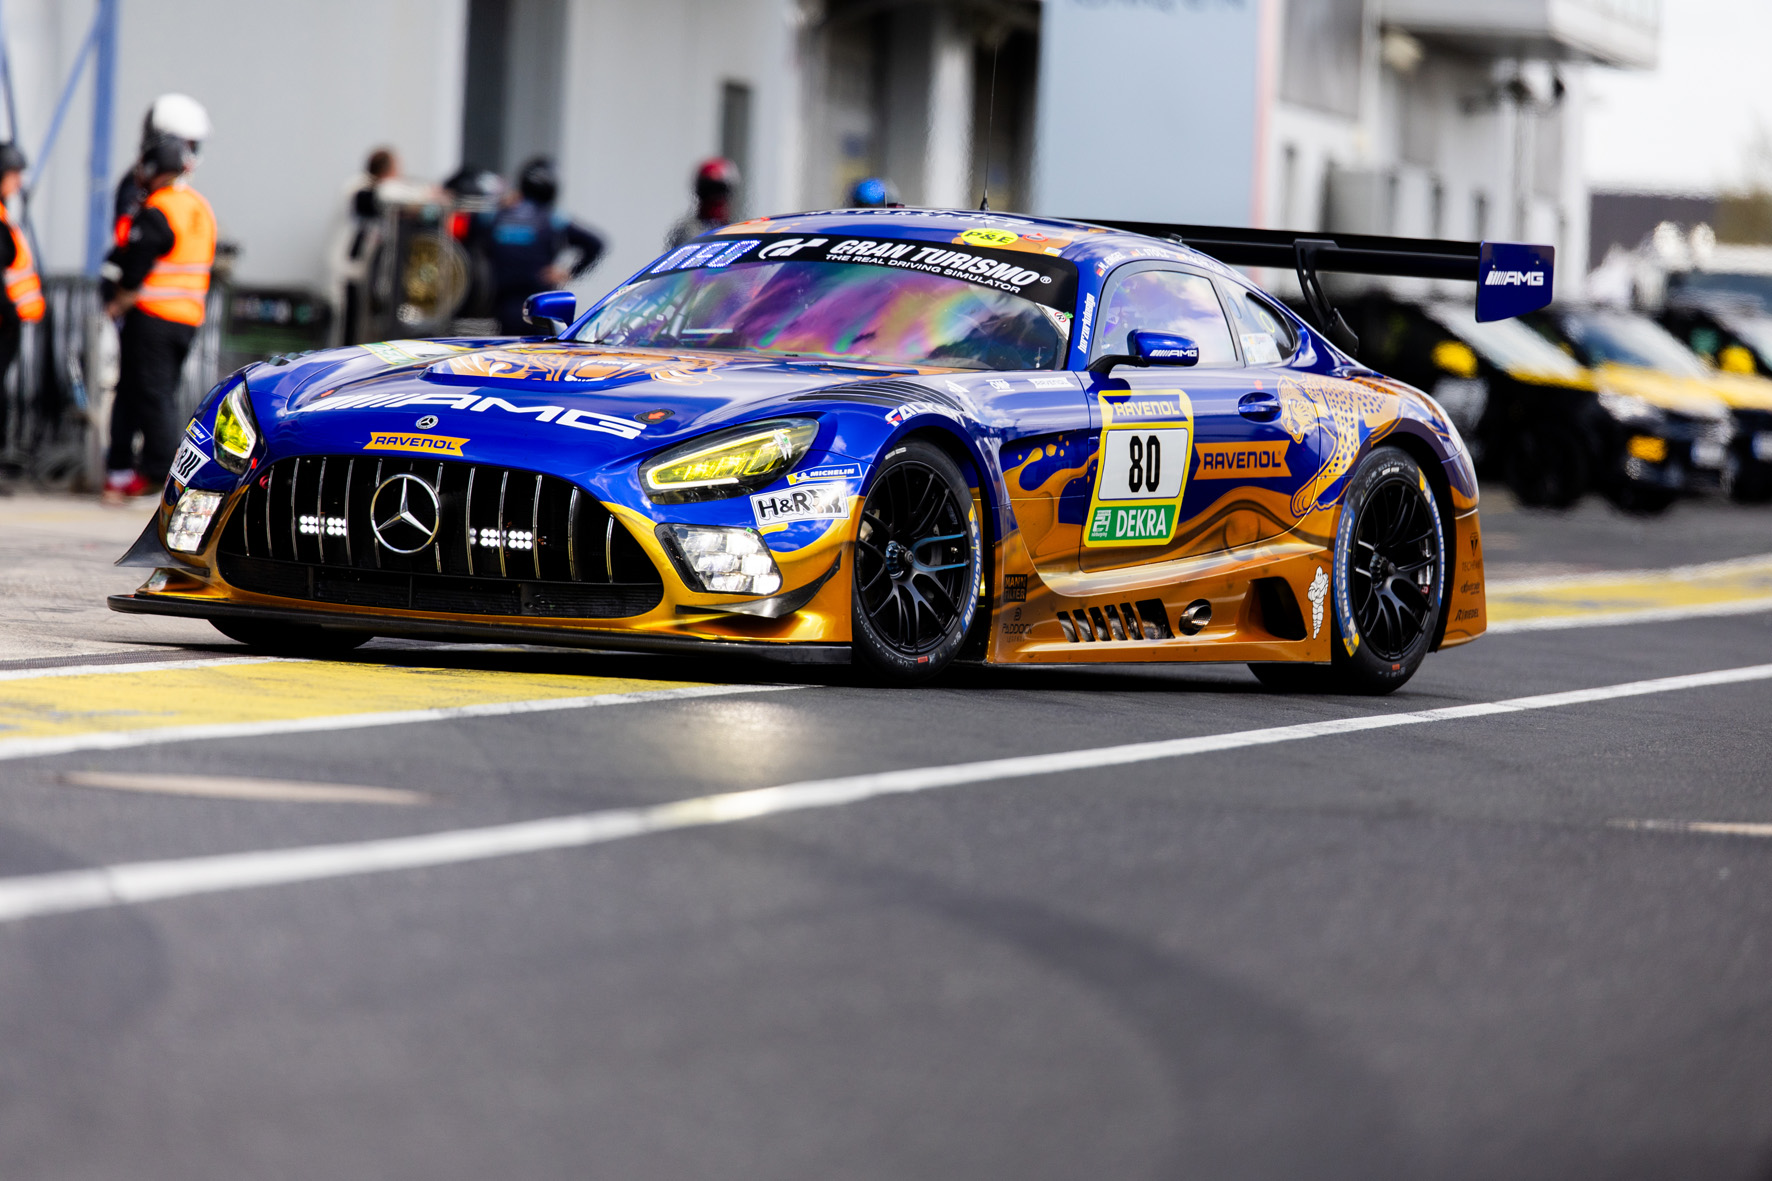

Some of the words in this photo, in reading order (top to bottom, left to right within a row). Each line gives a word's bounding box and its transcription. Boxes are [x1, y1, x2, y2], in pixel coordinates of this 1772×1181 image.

[964, 231, 1014, 244] P&E
[829, 240, 907, 261] GRAN
[911, 246, 1041, 287] TURISMO
[825, 253, 851, 263] THE
[852, 255, 885, 265] REAL
[887, 259, 941, 274] DRIVING
[943, 268, 1021, 294] SIMULATOR
[1502, 271, 1544, 286] AMG
[1167, 349, 1198, 358] AMG
[391, 393, 647, 440] AMG
[1113, 401, 1180, 417] RAVENOL
[374, 436, 456, 451] RAVENOL
[1128, 435, 1161, 493] 80
[1203, 450, 1282, 470] RAVENOL
[809, 467, 855, 478] MICHELIN
[757, 492, 812, 518] H&R
[1115, 508, 1167, 538] DEKRA
[964, 538, 982, 627] MICHELIN
[1005, 576, 1027, 588] MANN
[1004, 588, 1026, 600] FILTER
[1001, 623, 1033, 635] PADDOCK
